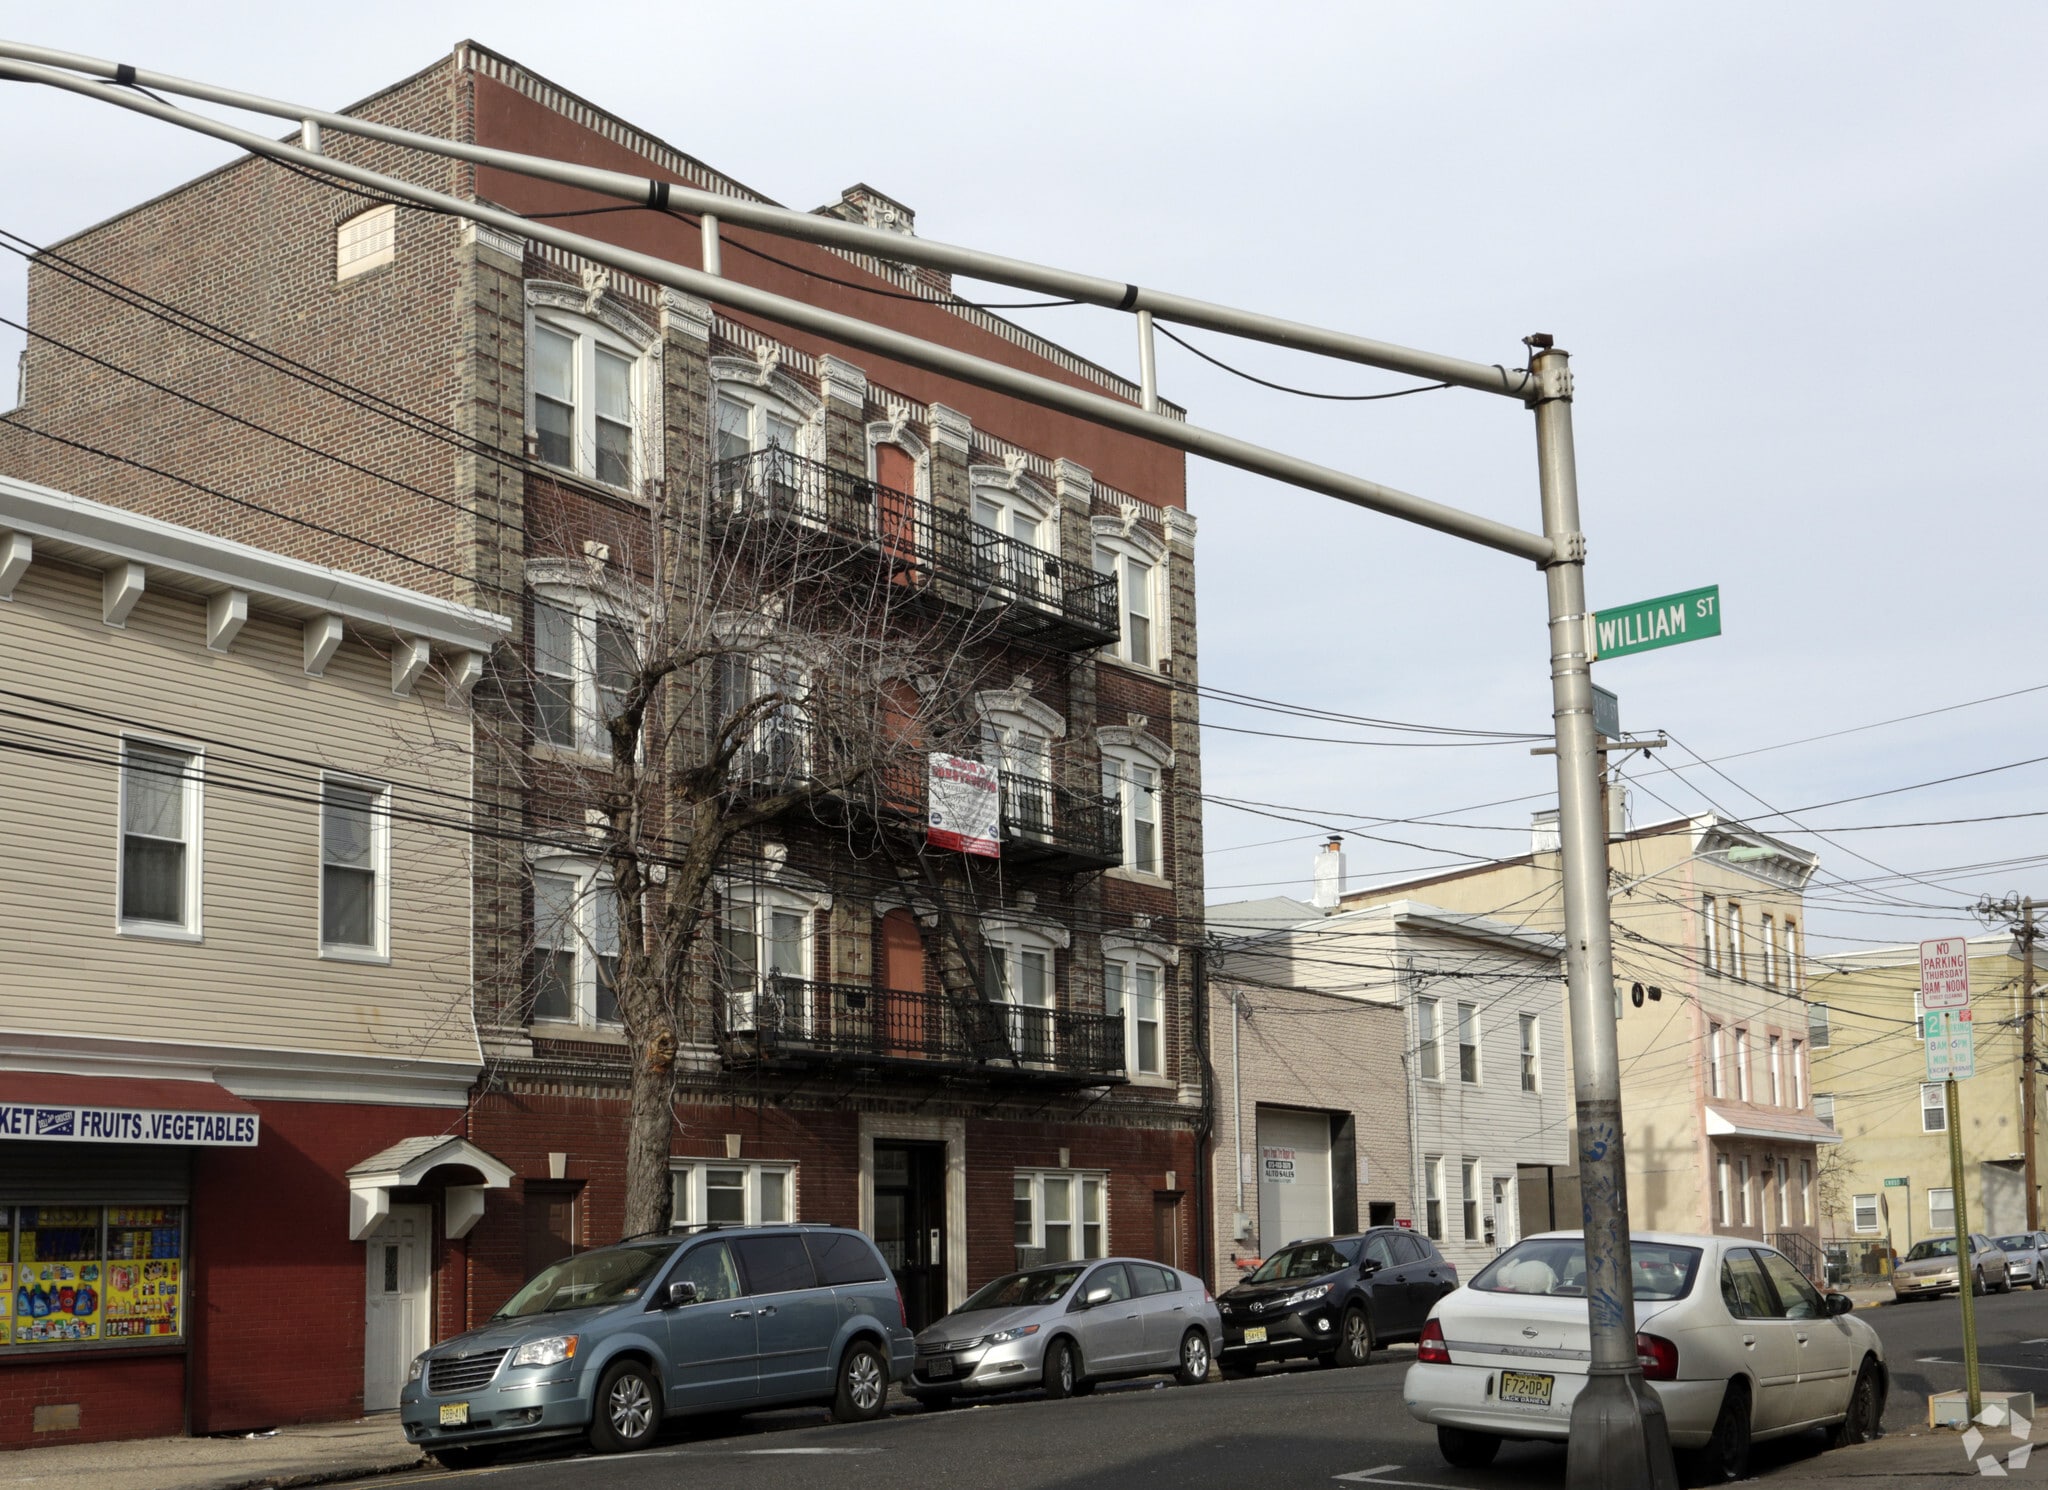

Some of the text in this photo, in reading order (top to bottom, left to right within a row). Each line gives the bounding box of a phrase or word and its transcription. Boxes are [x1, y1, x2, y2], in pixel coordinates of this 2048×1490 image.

[1599, 596, 1715, 651] WILLIAM ST
[1936, 942, 1949, 955] NO
[1924, 955, 1964, 970] PARKING
[1925, 968, 1963, 980] THURSDAY
[1929, 1016, 1938, 1033] 2
[1265, 1170, 1295, 1178] AUTO SALES
